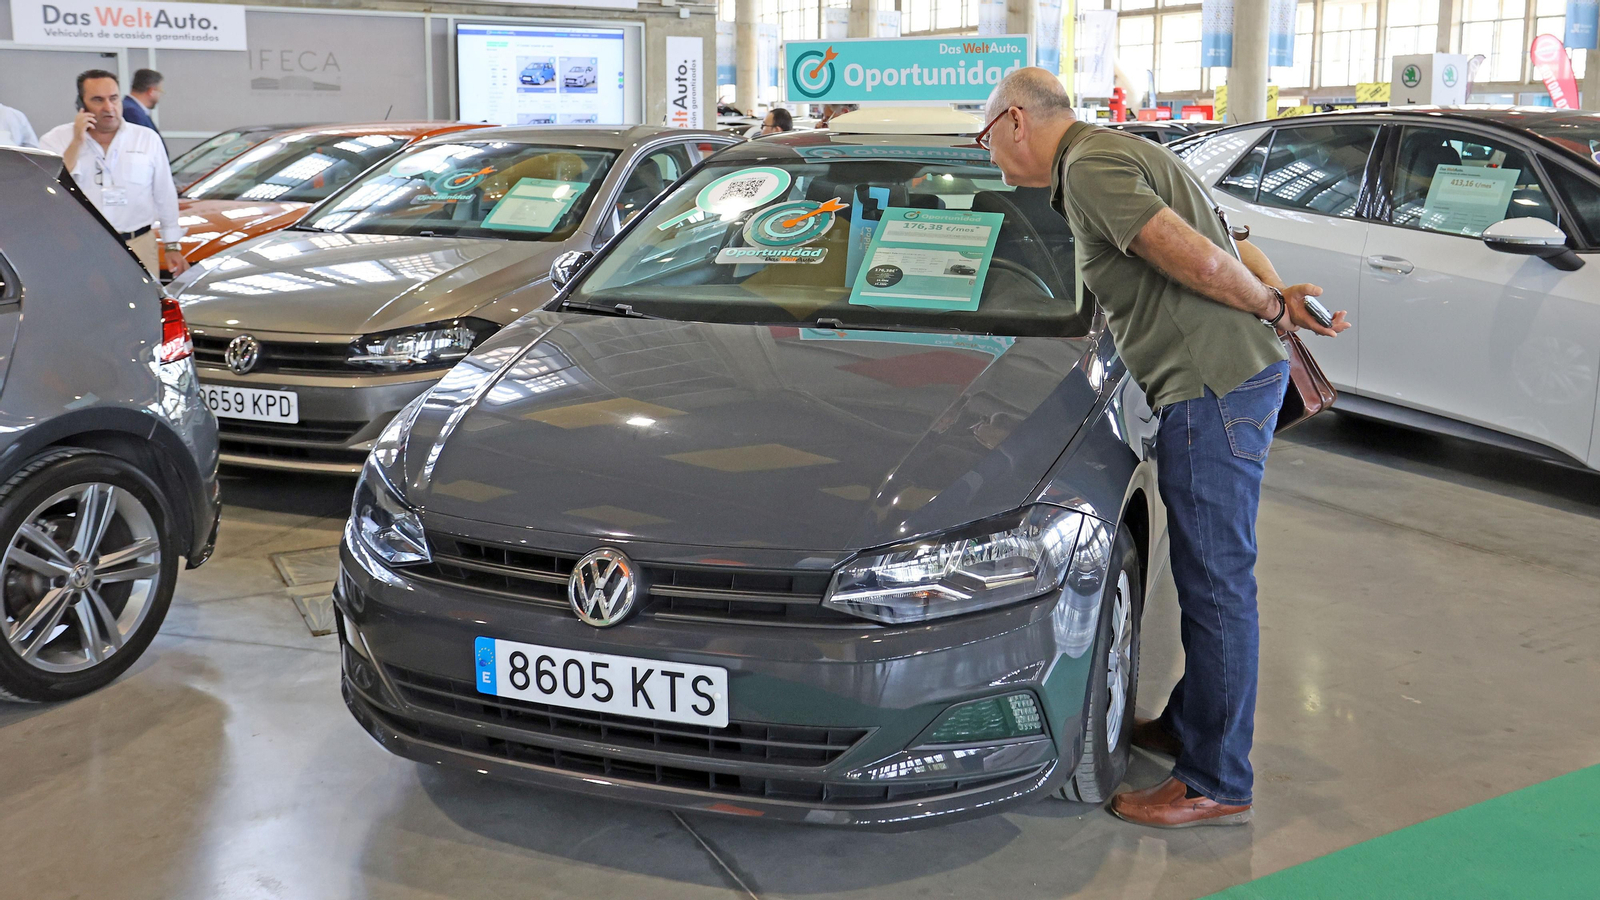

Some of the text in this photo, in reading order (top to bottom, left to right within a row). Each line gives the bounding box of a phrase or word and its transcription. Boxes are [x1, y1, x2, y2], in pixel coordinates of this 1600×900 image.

[42, 5, 218, 30] Das WeltAuto.
[97, 30, 111, 39] de
[113, 31, 153, 40] ocasión
[155, 33, 220, 42] garantizados
[939, 42, 1022, 55] Das WeltAuto.
[248, 49, 341, 72] IFECA
[690, 60, 698, 110] garantizados
[1451, 179, 1474, 187] 413,16
[921, 213, 982, 222] Oportunidad
[903, 222, 943, 231] 176,38
[725, 247, 823, 258] Oportunidad
[252, 393, 291, 417] KPD
[482, 671, 491, 683] E
[509, 650, 716, 717] 8605 KTS
